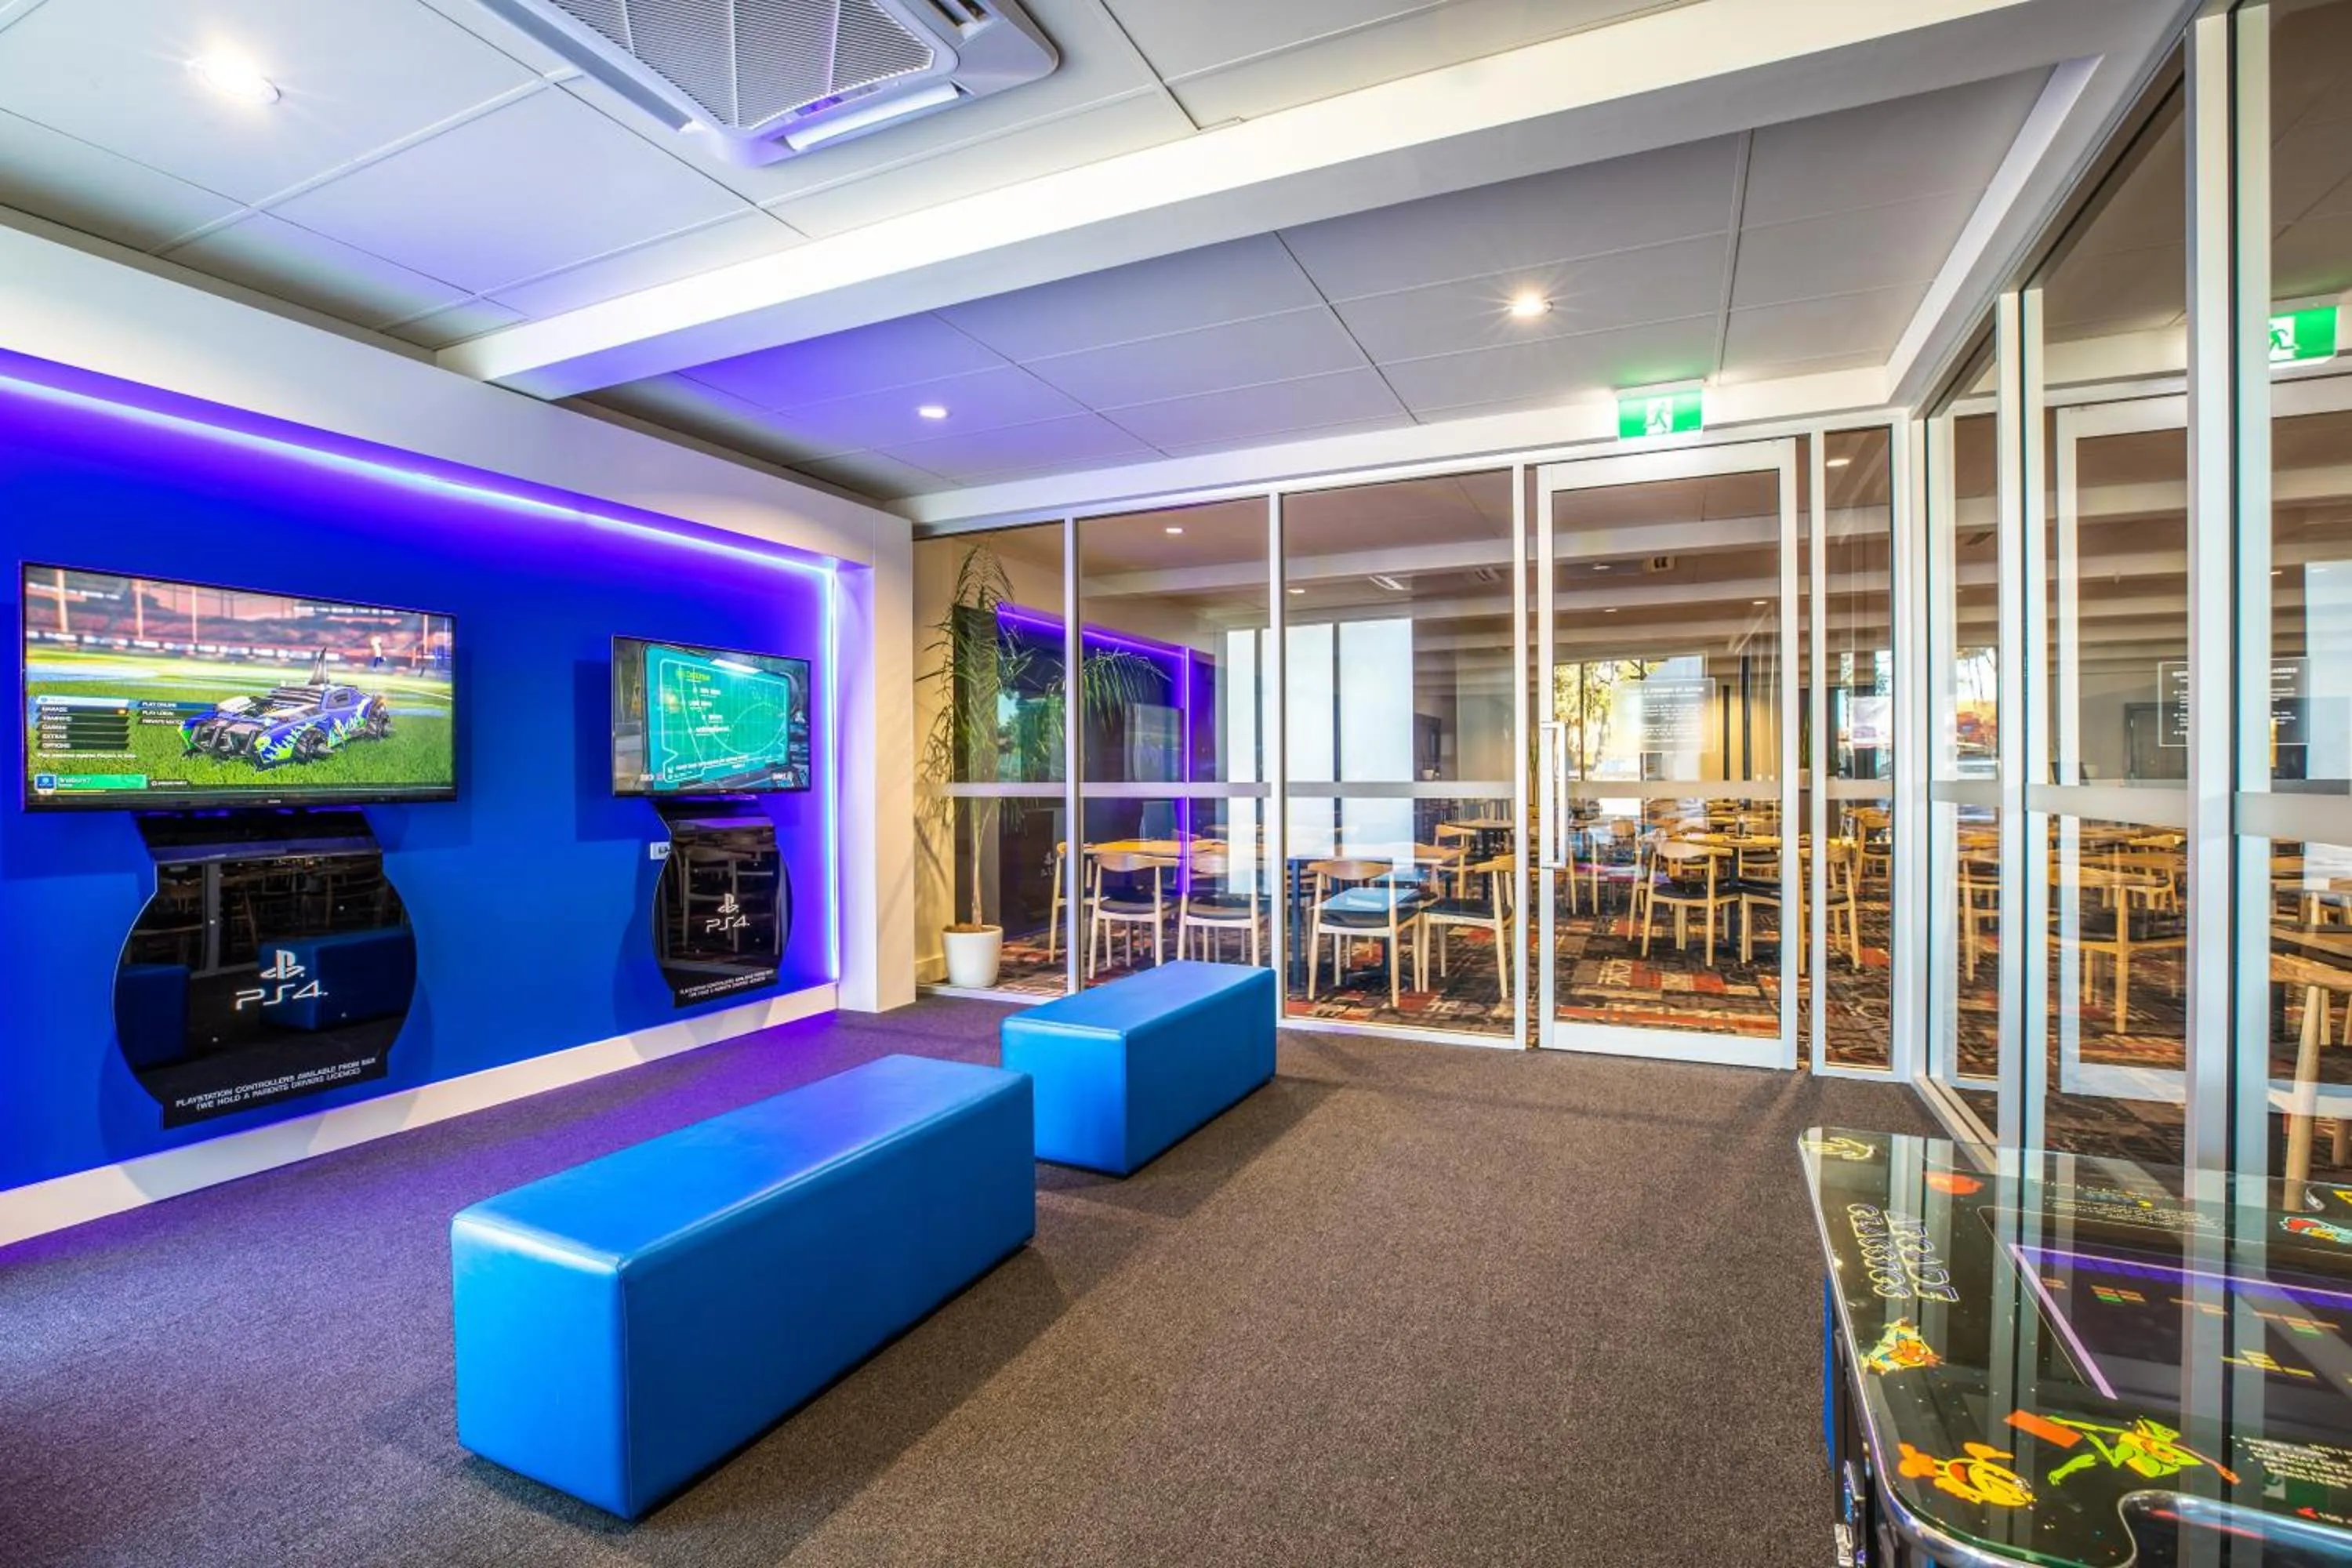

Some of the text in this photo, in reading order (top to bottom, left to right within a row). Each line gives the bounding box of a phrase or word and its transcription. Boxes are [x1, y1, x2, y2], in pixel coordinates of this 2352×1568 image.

[706, 915, 749, 934] PS4
[235, 979, 323, 1011] PS4
[176, 1088, 233, 1107] PLAYSTATION
[235, 1075, 296, 1093] CONTROLLERS
[298, 1066, 336, 1080] AVAILABLE
[339, 1061, 360, 1071] FROM
[217, 1094, 241, 1106] HOLD
[252, 1083, 290, 1098] PARENTS
[291, 1075, 325, 1089] DRIVERS
